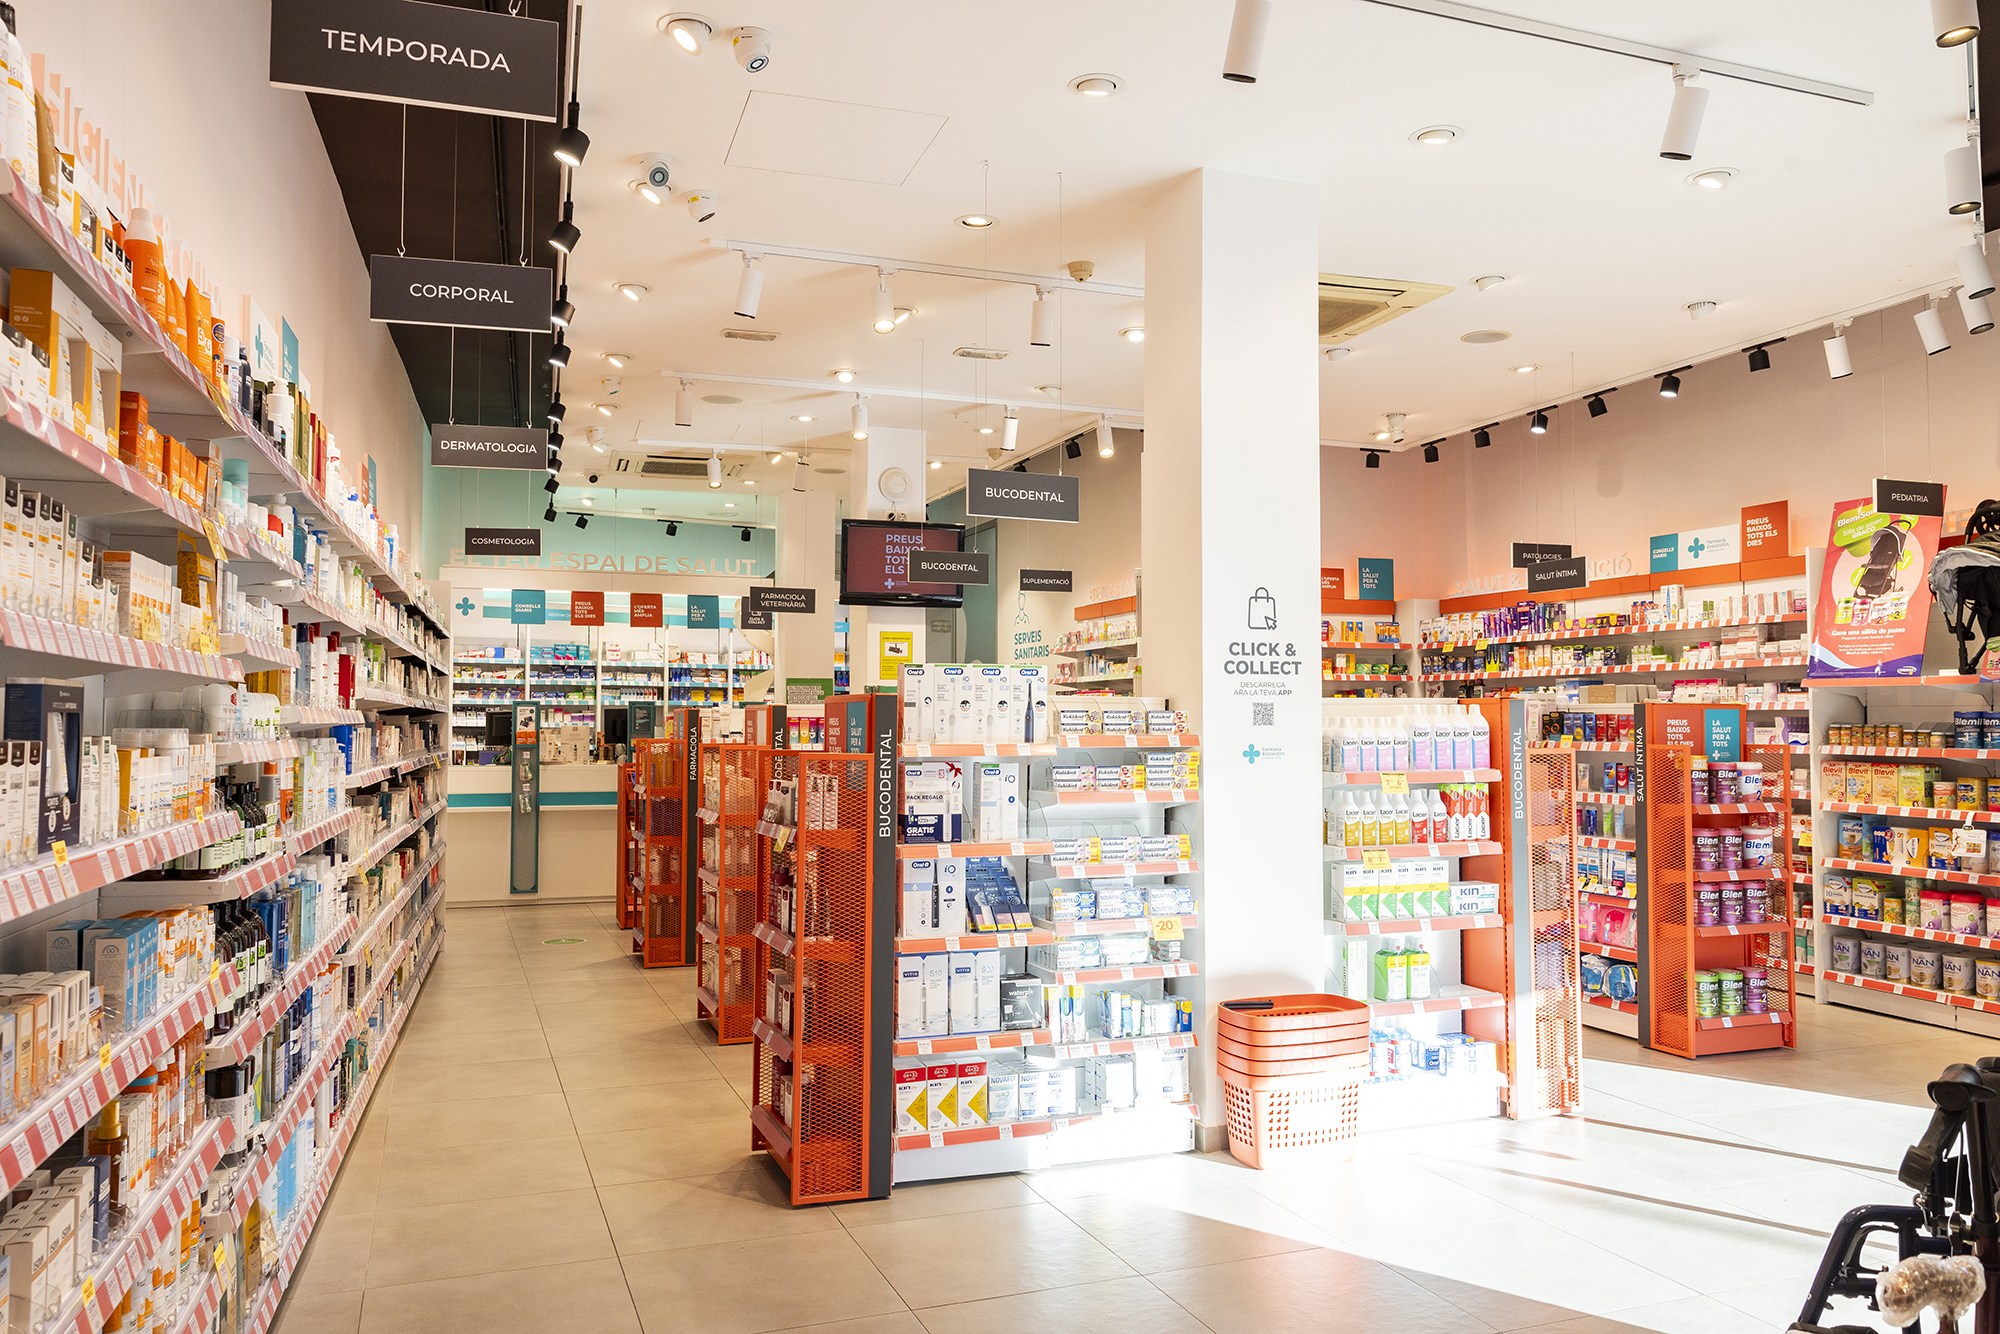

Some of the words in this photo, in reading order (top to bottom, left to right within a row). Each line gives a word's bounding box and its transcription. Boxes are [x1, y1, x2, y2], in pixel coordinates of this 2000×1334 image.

[321, 28, 511, 73] TEMPORADA
[409, 283, 514, 304] CORPORAL
[440, 439, 537, 454] DERMATOLOGIA
[985, 487, 1064, 504] BUCODENTAL
[1891, 493, 1928, 503] PEDIATRIA
[1746, 517, 1769, 526] PREUS
[1746, 524, 1772, 533] BAIXOS
[1851, 526, 1876, 539] GRACO
[886, 534, 922, 544] PREUS
[1746, 531, 1764, 540] TOTS
[1764, 530, 1778, 538] ELS
[471, 537, 535, 546] COSMETOLOGIA
[1746, 539, 1763, 547] DIES
[1522, 552, 1562, 560] PATOLOGIES
[550, 552, 625, 572] ESPAI
[634, 555, 668, 573] DE
[676, 556, 757, 576] SALUT
[921, 562, 978, 572] BUCODENTAL
[885, 566, 905, 575] ELS
[1535, 570, 1554, 581] SALUT
[1555, 569, 1578, 579] ÍNTIMA
[1022, 577, 1070, 585] SUPLEMENTACIÓ
[1454, 574, 1505, 596] SALUT
[761, 592, 806, 600] FARMACIOLA
[760, 600, 806, 608] VETERINÀRIA
[1014, 630, 1042, 646] SERVEIS
[1014, 645, 1050, 660] SANITARIS
[1228, 641, 1281, 657] CLICK
[1284, 643, 1297, 657] &
[1223, 660, 1302, 675] COLLECT
[850, 717, 856, 726] LA
[1435, 730, 1451, 738] Lacer
[1472, 729, 1489, 737] Lacer
[1712, 726, 1732, 734] SALUT
[850, 737, 858, 745] PER
[1634, 727, 1643, 766] ÍNTIMA
[689, 726, 698, 781] FARMACIOLA
[1513, 728, 1524, 819] BUCODENTAL
[1822, 766, 1843, 774] Blevit
[1848, 767, 1869, 775] Blevit
[1873, 768, 1895, 776] Blevit
[1900, 769, 1921, 777] Blevit
[879, 728, 892, 837] BUCODENTAL
[1004, 774, 1016, 783] iO
[1636, 772, 1644, 802] SALUT
[906, 826, 935, 834] GRATIS
[1155, 920, 1174, 931] -20
[1912, 957, 1935, 967] NAN
[929, 969, 943, 977] S10
[1008, 987, 1034, 996] waterpik
[990, 1075, 1017, 1084] NOVAFIX
